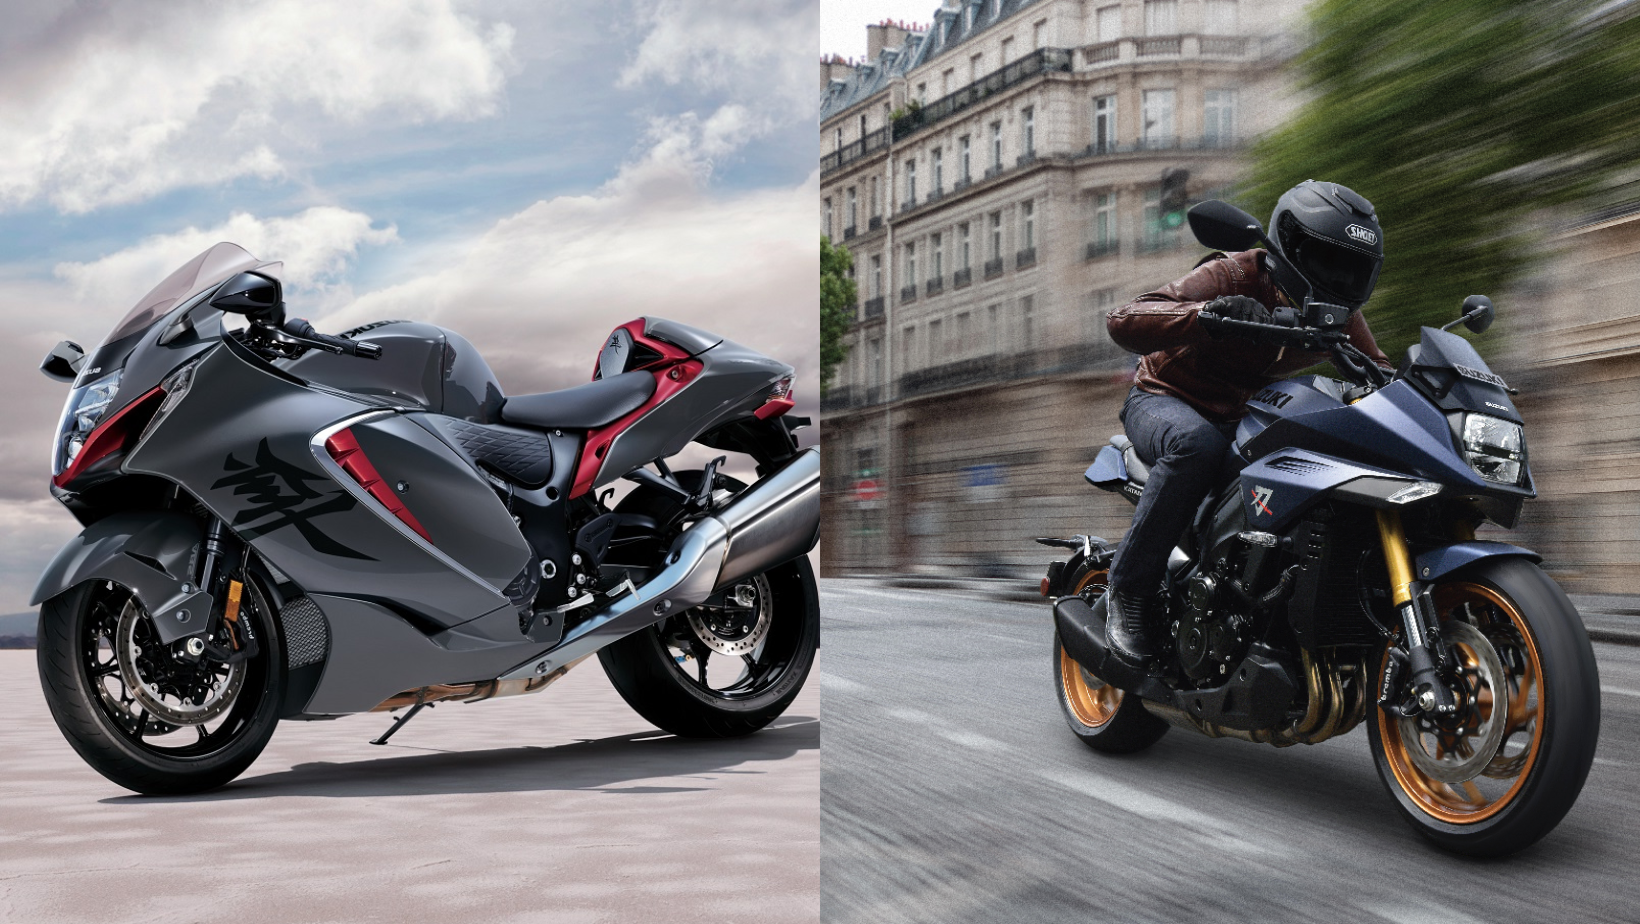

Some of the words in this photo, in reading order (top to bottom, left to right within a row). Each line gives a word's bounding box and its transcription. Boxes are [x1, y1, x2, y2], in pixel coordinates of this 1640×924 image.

[1350, 226, 1375, 243] SHOEI
[1455, 364, 1507, 389] SUZUKI
[1484, 401, 1509, 412] SUZUKI
[1123, 485, 1142, 497] KATAN
[1380, 660, 1395, 701] brembo
